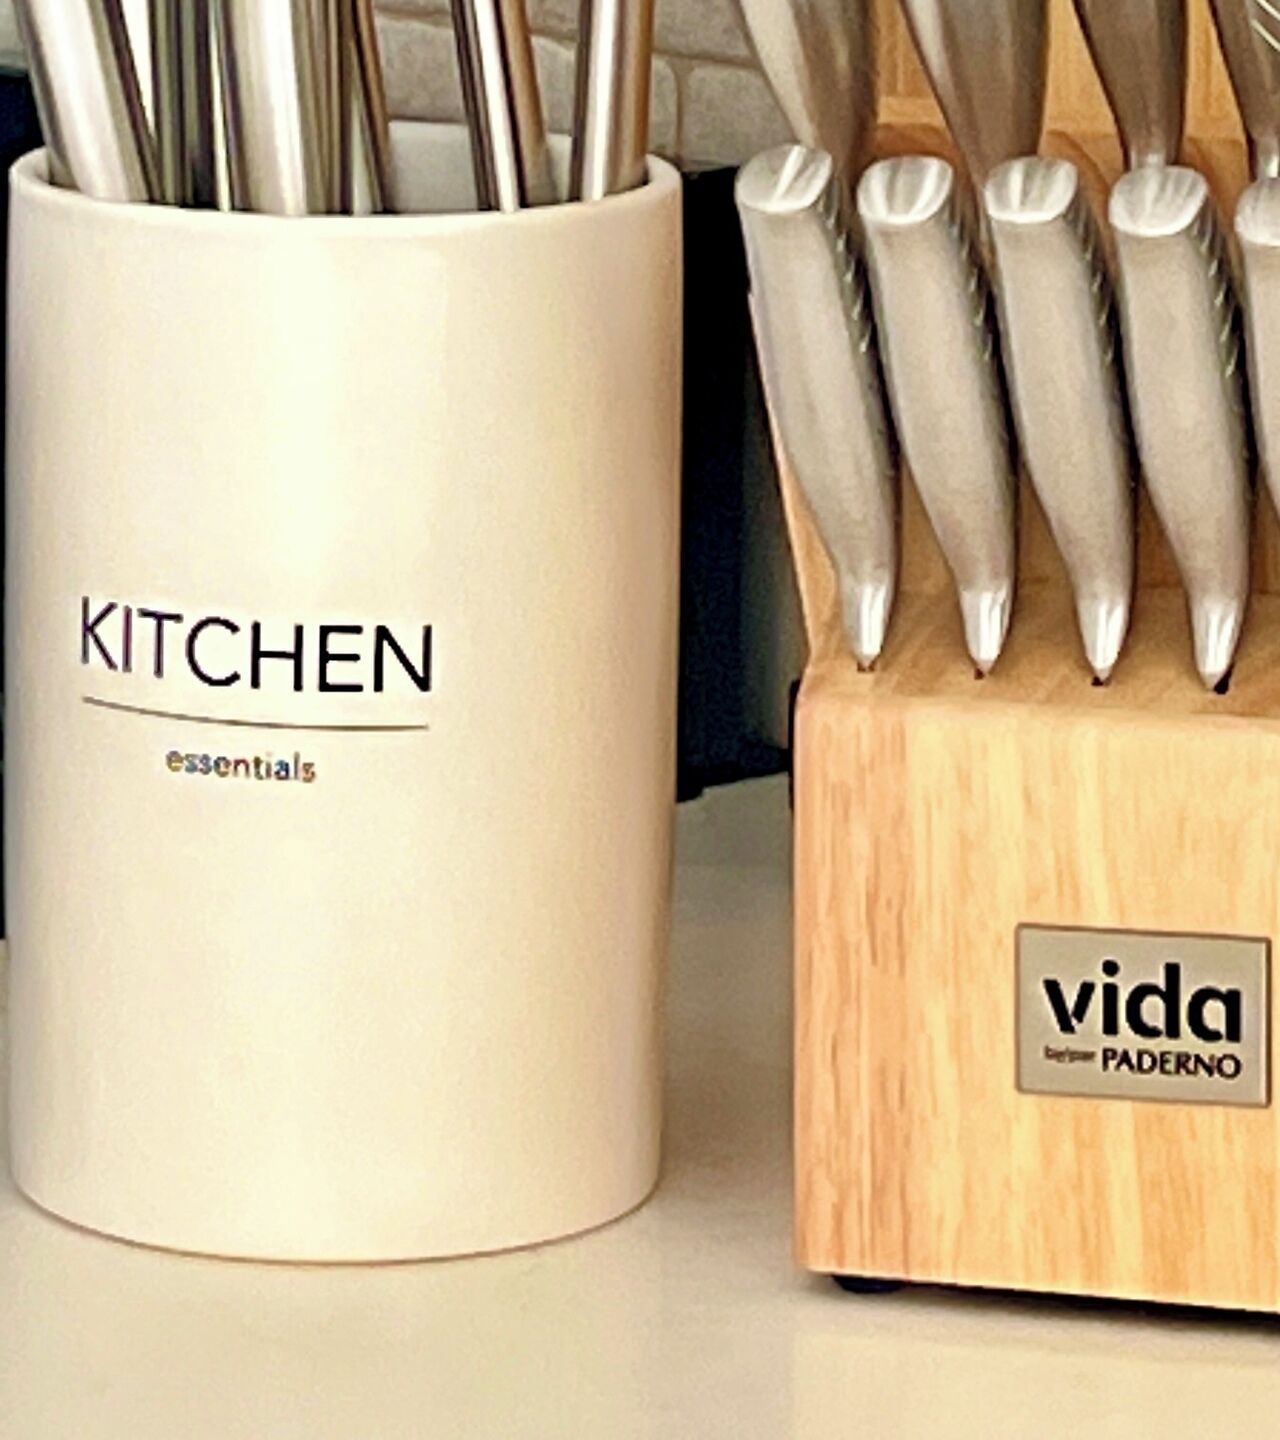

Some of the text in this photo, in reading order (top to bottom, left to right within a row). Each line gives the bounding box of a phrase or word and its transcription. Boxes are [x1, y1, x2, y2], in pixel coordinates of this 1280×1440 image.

[81, 596, 433, 694] KITCHEN
[165, 749, 316, 783] essentials
[1043, 959, 1242, 1043] vida
[1102, 1046, 1243, 1080] PADERNO
